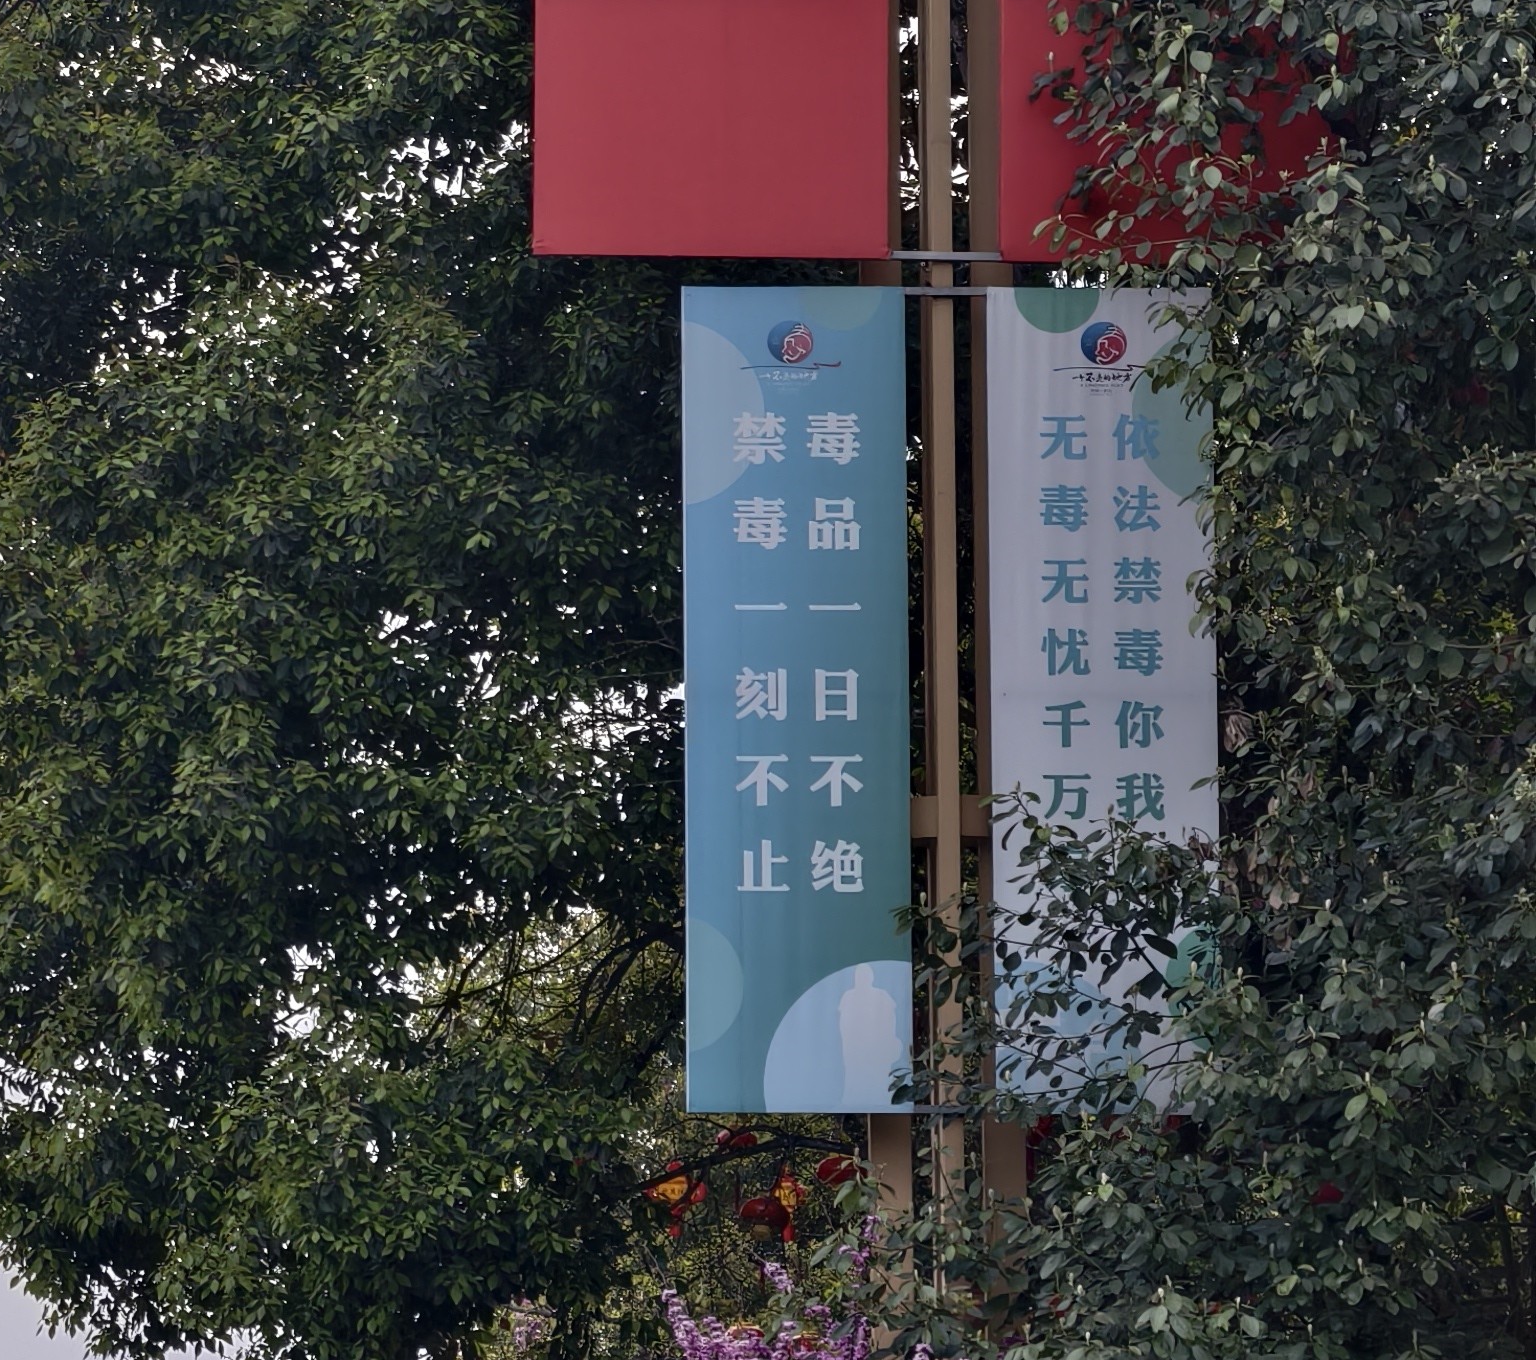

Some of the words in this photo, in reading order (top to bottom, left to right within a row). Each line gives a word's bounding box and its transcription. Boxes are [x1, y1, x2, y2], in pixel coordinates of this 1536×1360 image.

[732, 411, 790, 893] 禁毒一刻不止
[806, 411, 864, 893] 毒品一日不绝
[1040, 414, 1092, 885] 无毒无忧千万
[1112, 414, 1166, 885] 依法禁毒你我
